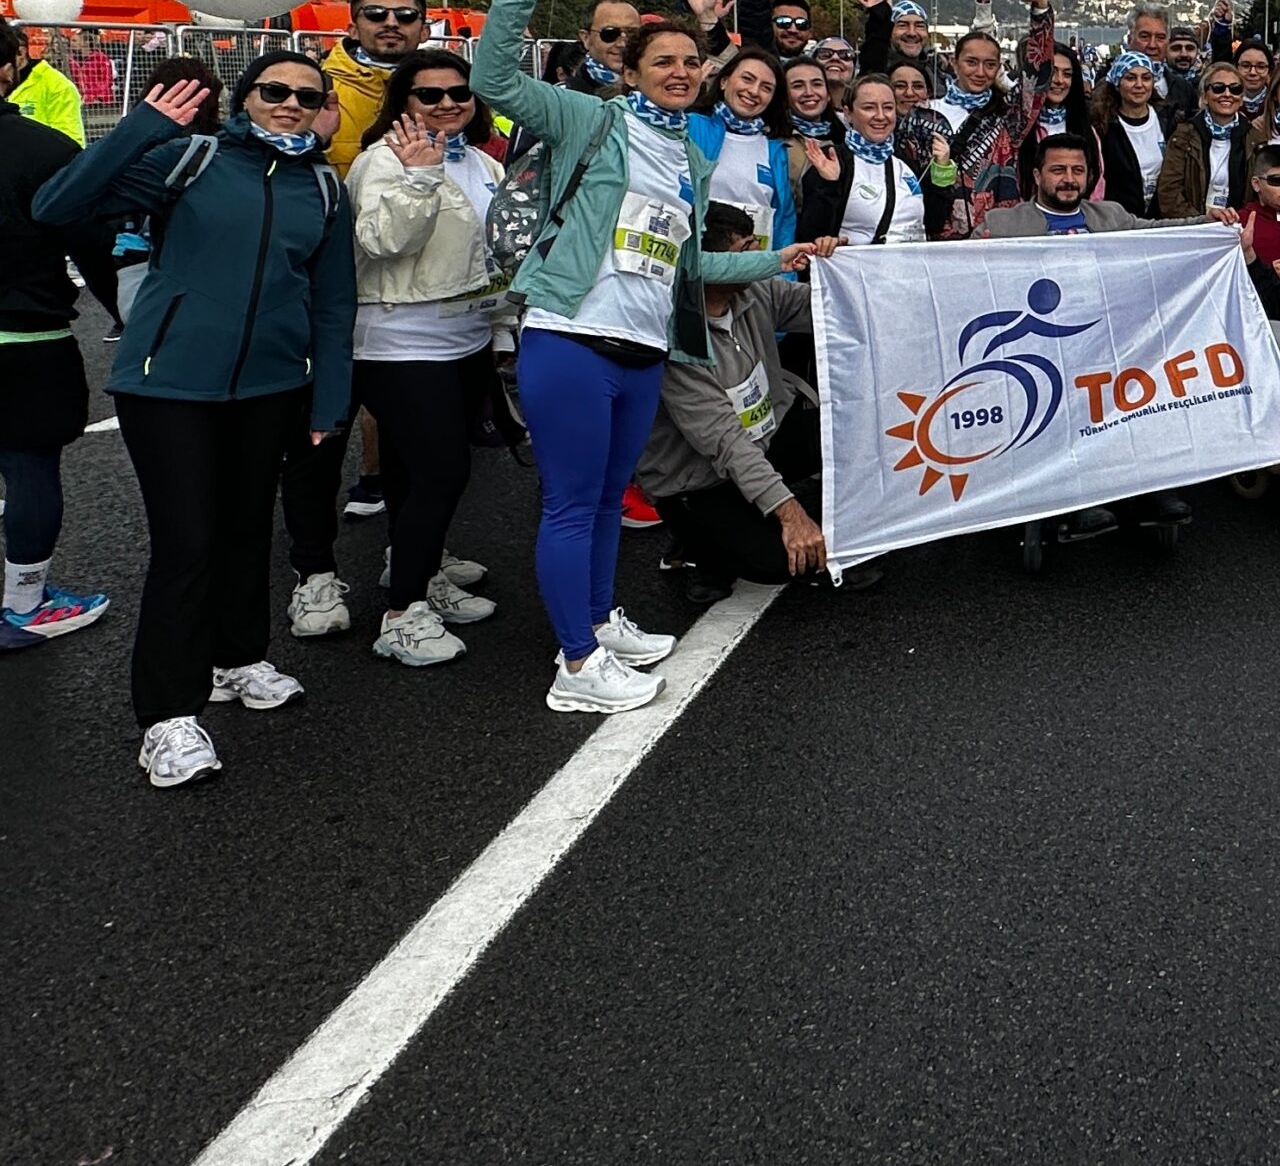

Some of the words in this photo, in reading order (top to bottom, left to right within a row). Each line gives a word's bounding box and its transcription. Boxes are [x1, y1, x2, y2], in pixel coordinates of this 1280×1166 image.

[1075, 342, 1245, 423] TOFD
[950, 405, 1004, 430] 1998
[1120, 403, 1168, 424] OMURİLİK
[1167, 391, 1217, 411] FELÇLİLERİ
